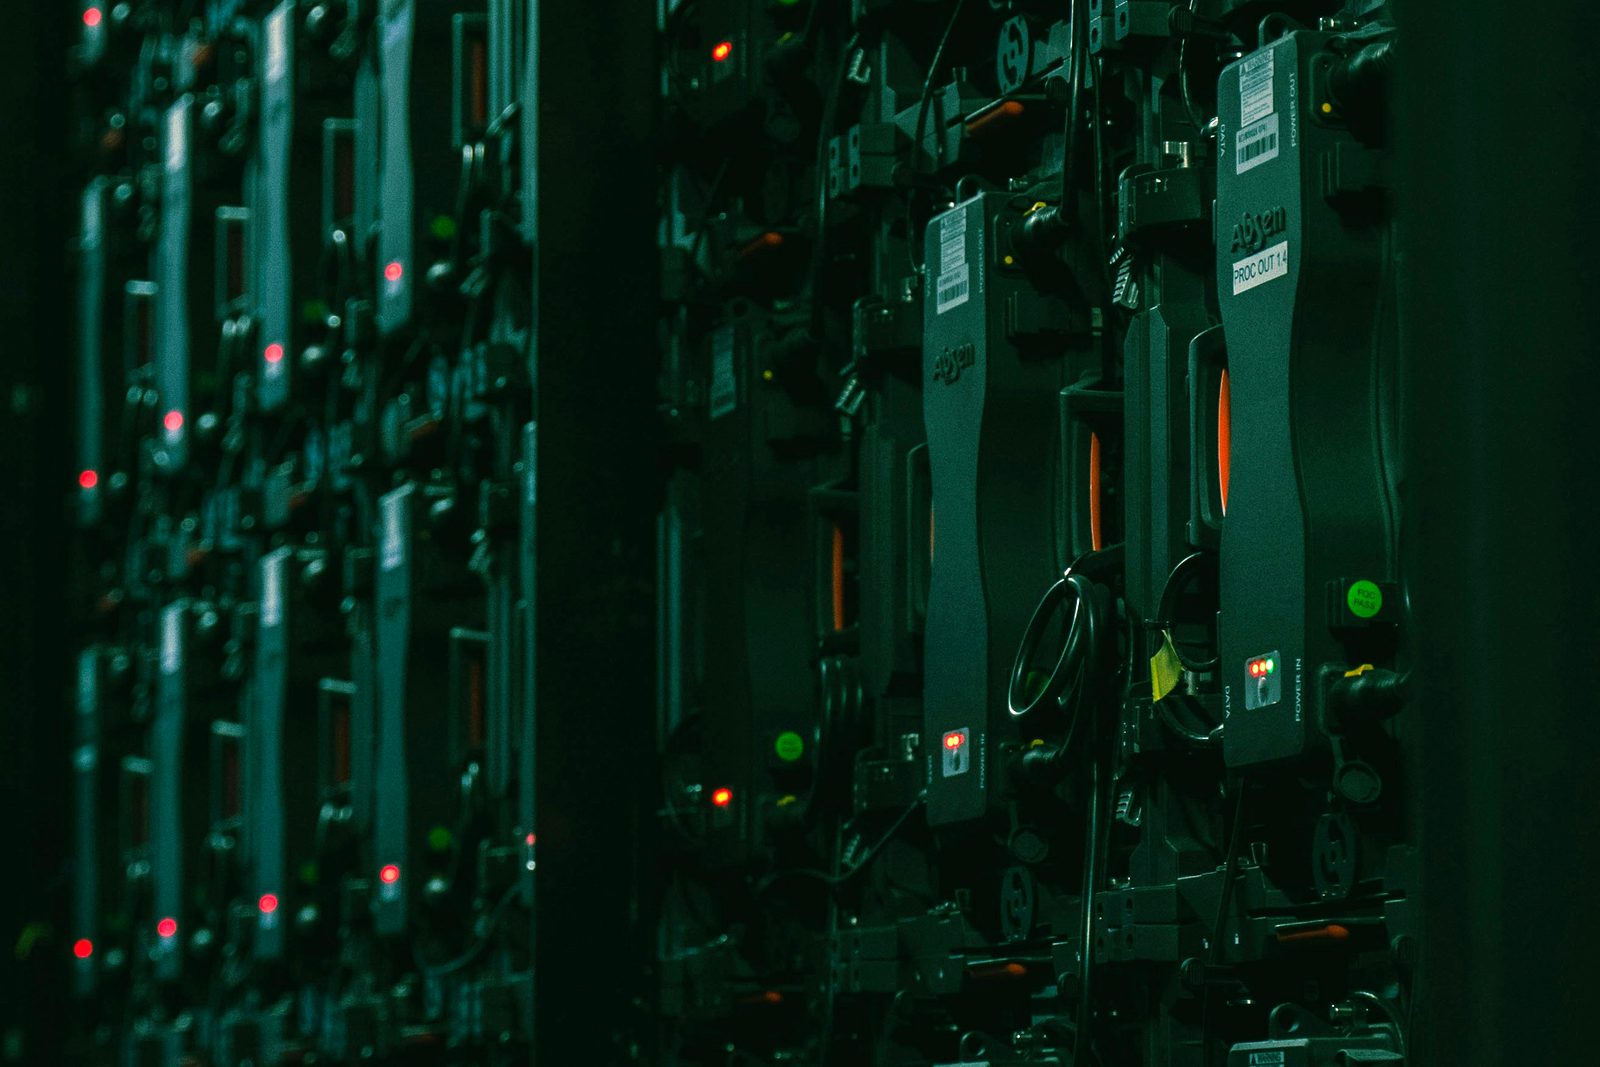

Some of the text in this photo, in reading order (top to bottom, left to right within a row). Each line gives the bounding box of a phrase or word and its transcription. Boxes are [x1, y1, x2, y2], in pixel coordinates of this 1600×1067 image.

[1288, 72, 1297, 148] POWER OUT
[1231, 206, 1286, 254] Absen
[1234, 262, 1257, 284] PROC
[1258, 254, 1275, 275] OUT
[933, 343, 976, 386] Absen
[1354, 597, 1376, 609] PASS
[1295, 658, 1302, 671] IN
